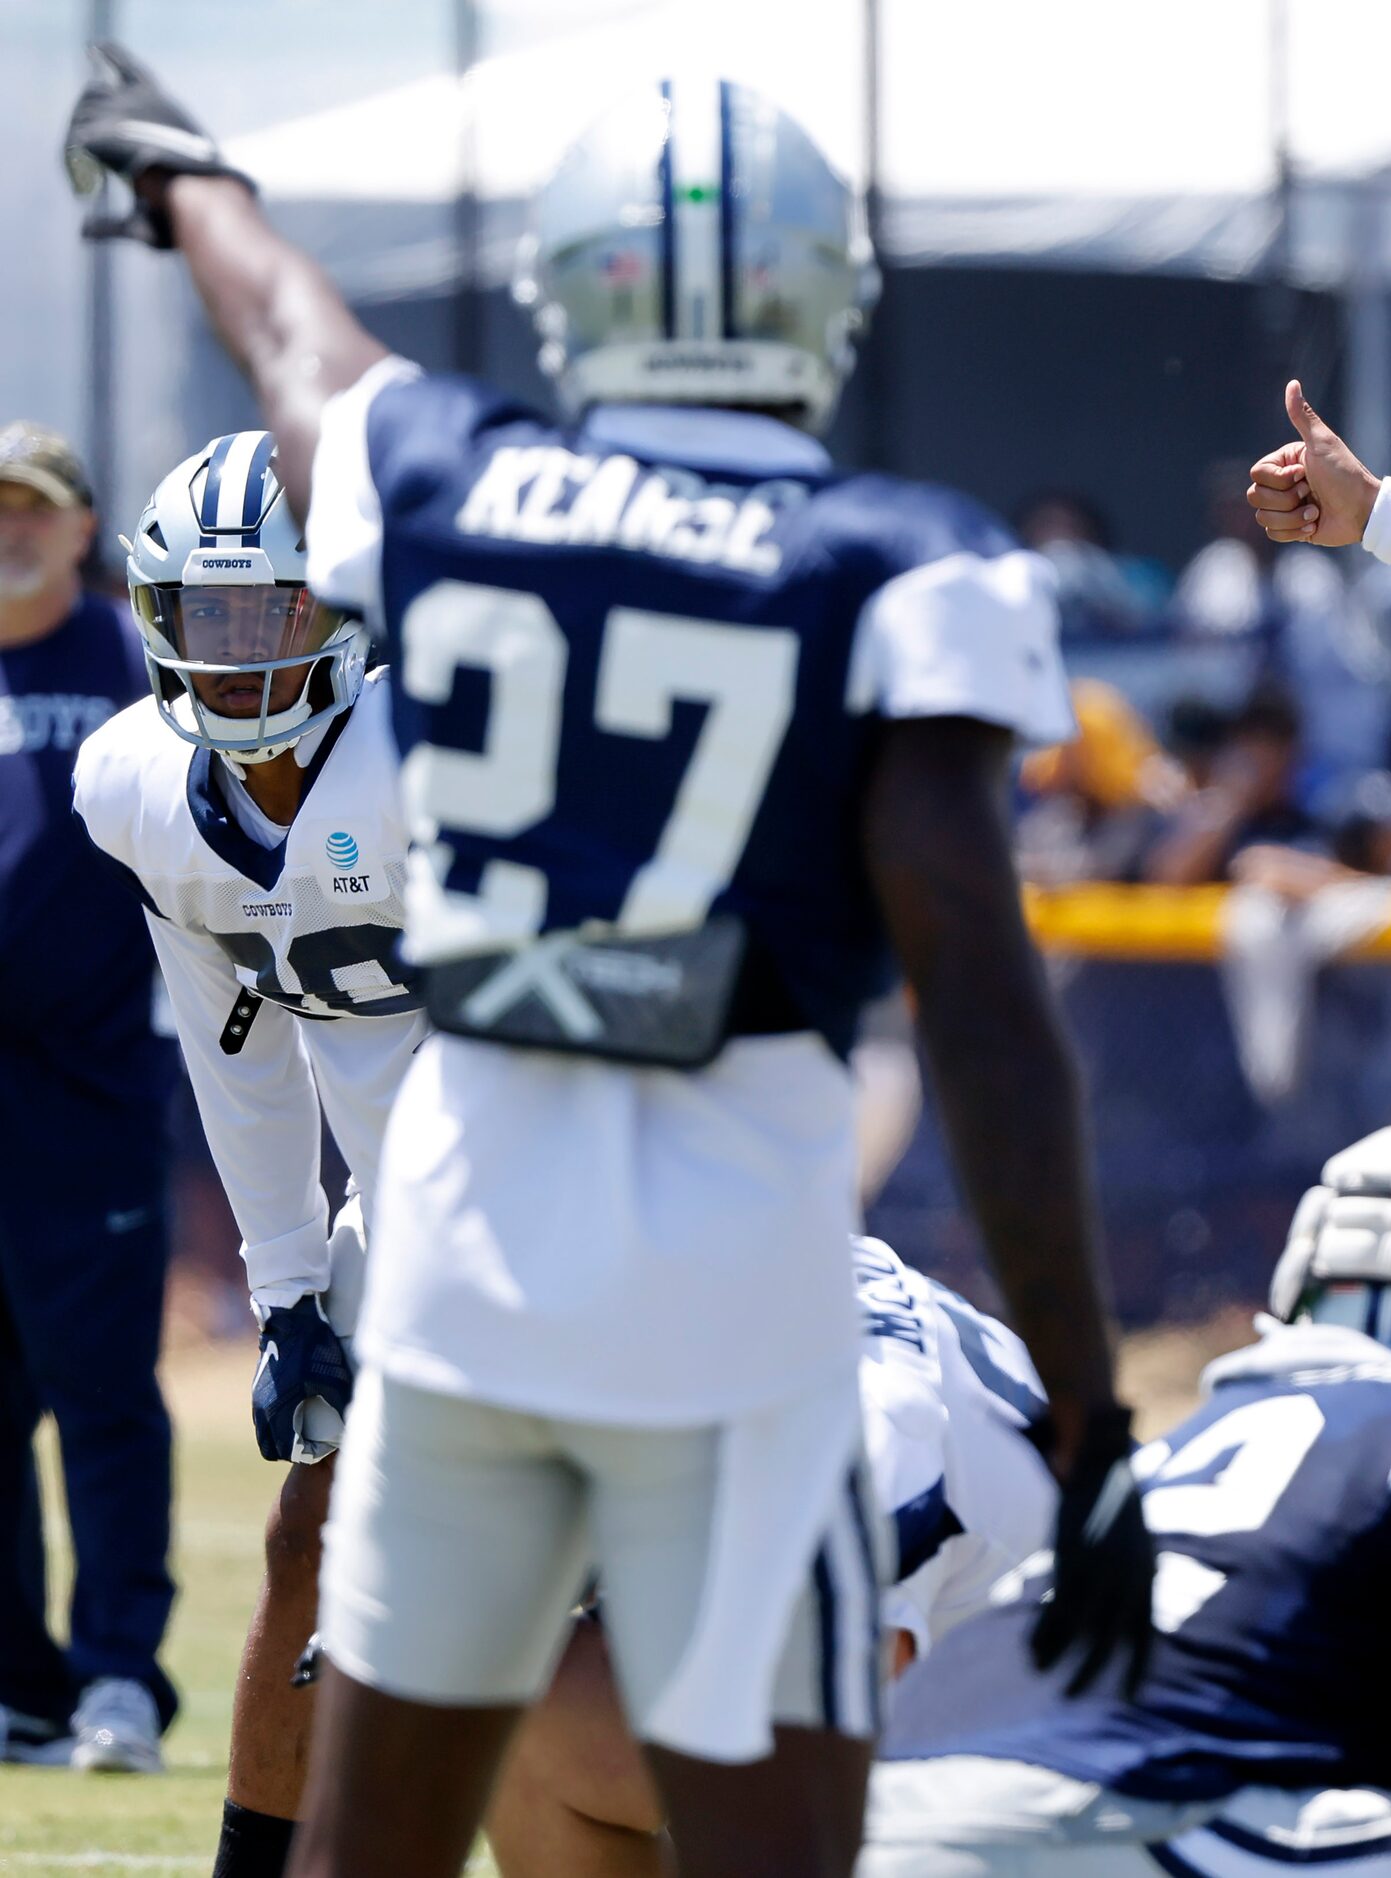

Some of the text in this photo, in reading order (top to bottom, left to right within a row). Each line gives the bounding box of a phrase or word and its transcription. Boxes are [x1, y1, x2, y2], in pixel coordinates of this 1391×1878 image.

[202, 559, 252, 569] COWBOYS
[400, 579, 801, 966] 27
[333, 875, 370, 893] AT&T
[242, 903, 293, 917] COWBOYS
